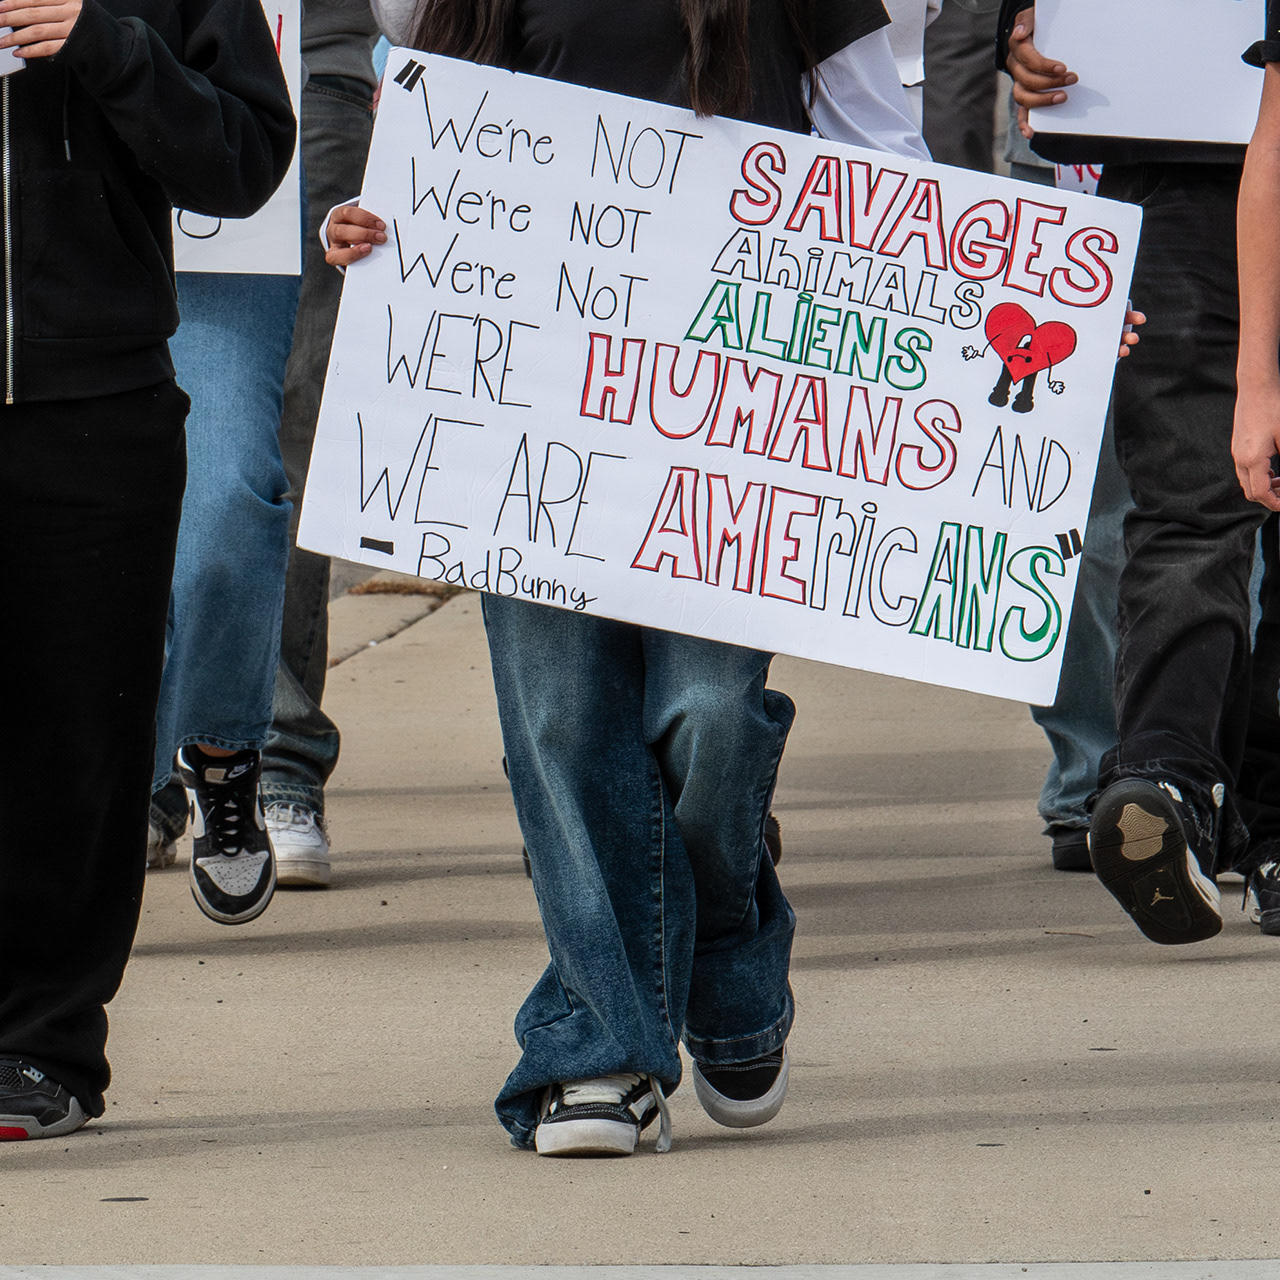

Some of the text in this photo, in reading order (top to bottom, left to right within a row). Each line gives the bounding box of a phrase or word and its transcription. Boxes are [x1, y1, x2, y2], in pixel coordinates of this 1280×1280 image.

[393, 218, 517, 299] We're
[411, 156, 532, 232] We're
[570, 201, 652, 253] NOT
[591, 114, 704, 194] NOT
[729, 141, 1119, 308] SAVAGES
[357, 412, 485, 529] WE
[493, 432, 630, 562] ARE
[579, 332, 962, 491] HUMANS
[972, 425, 1072, 513] AND
